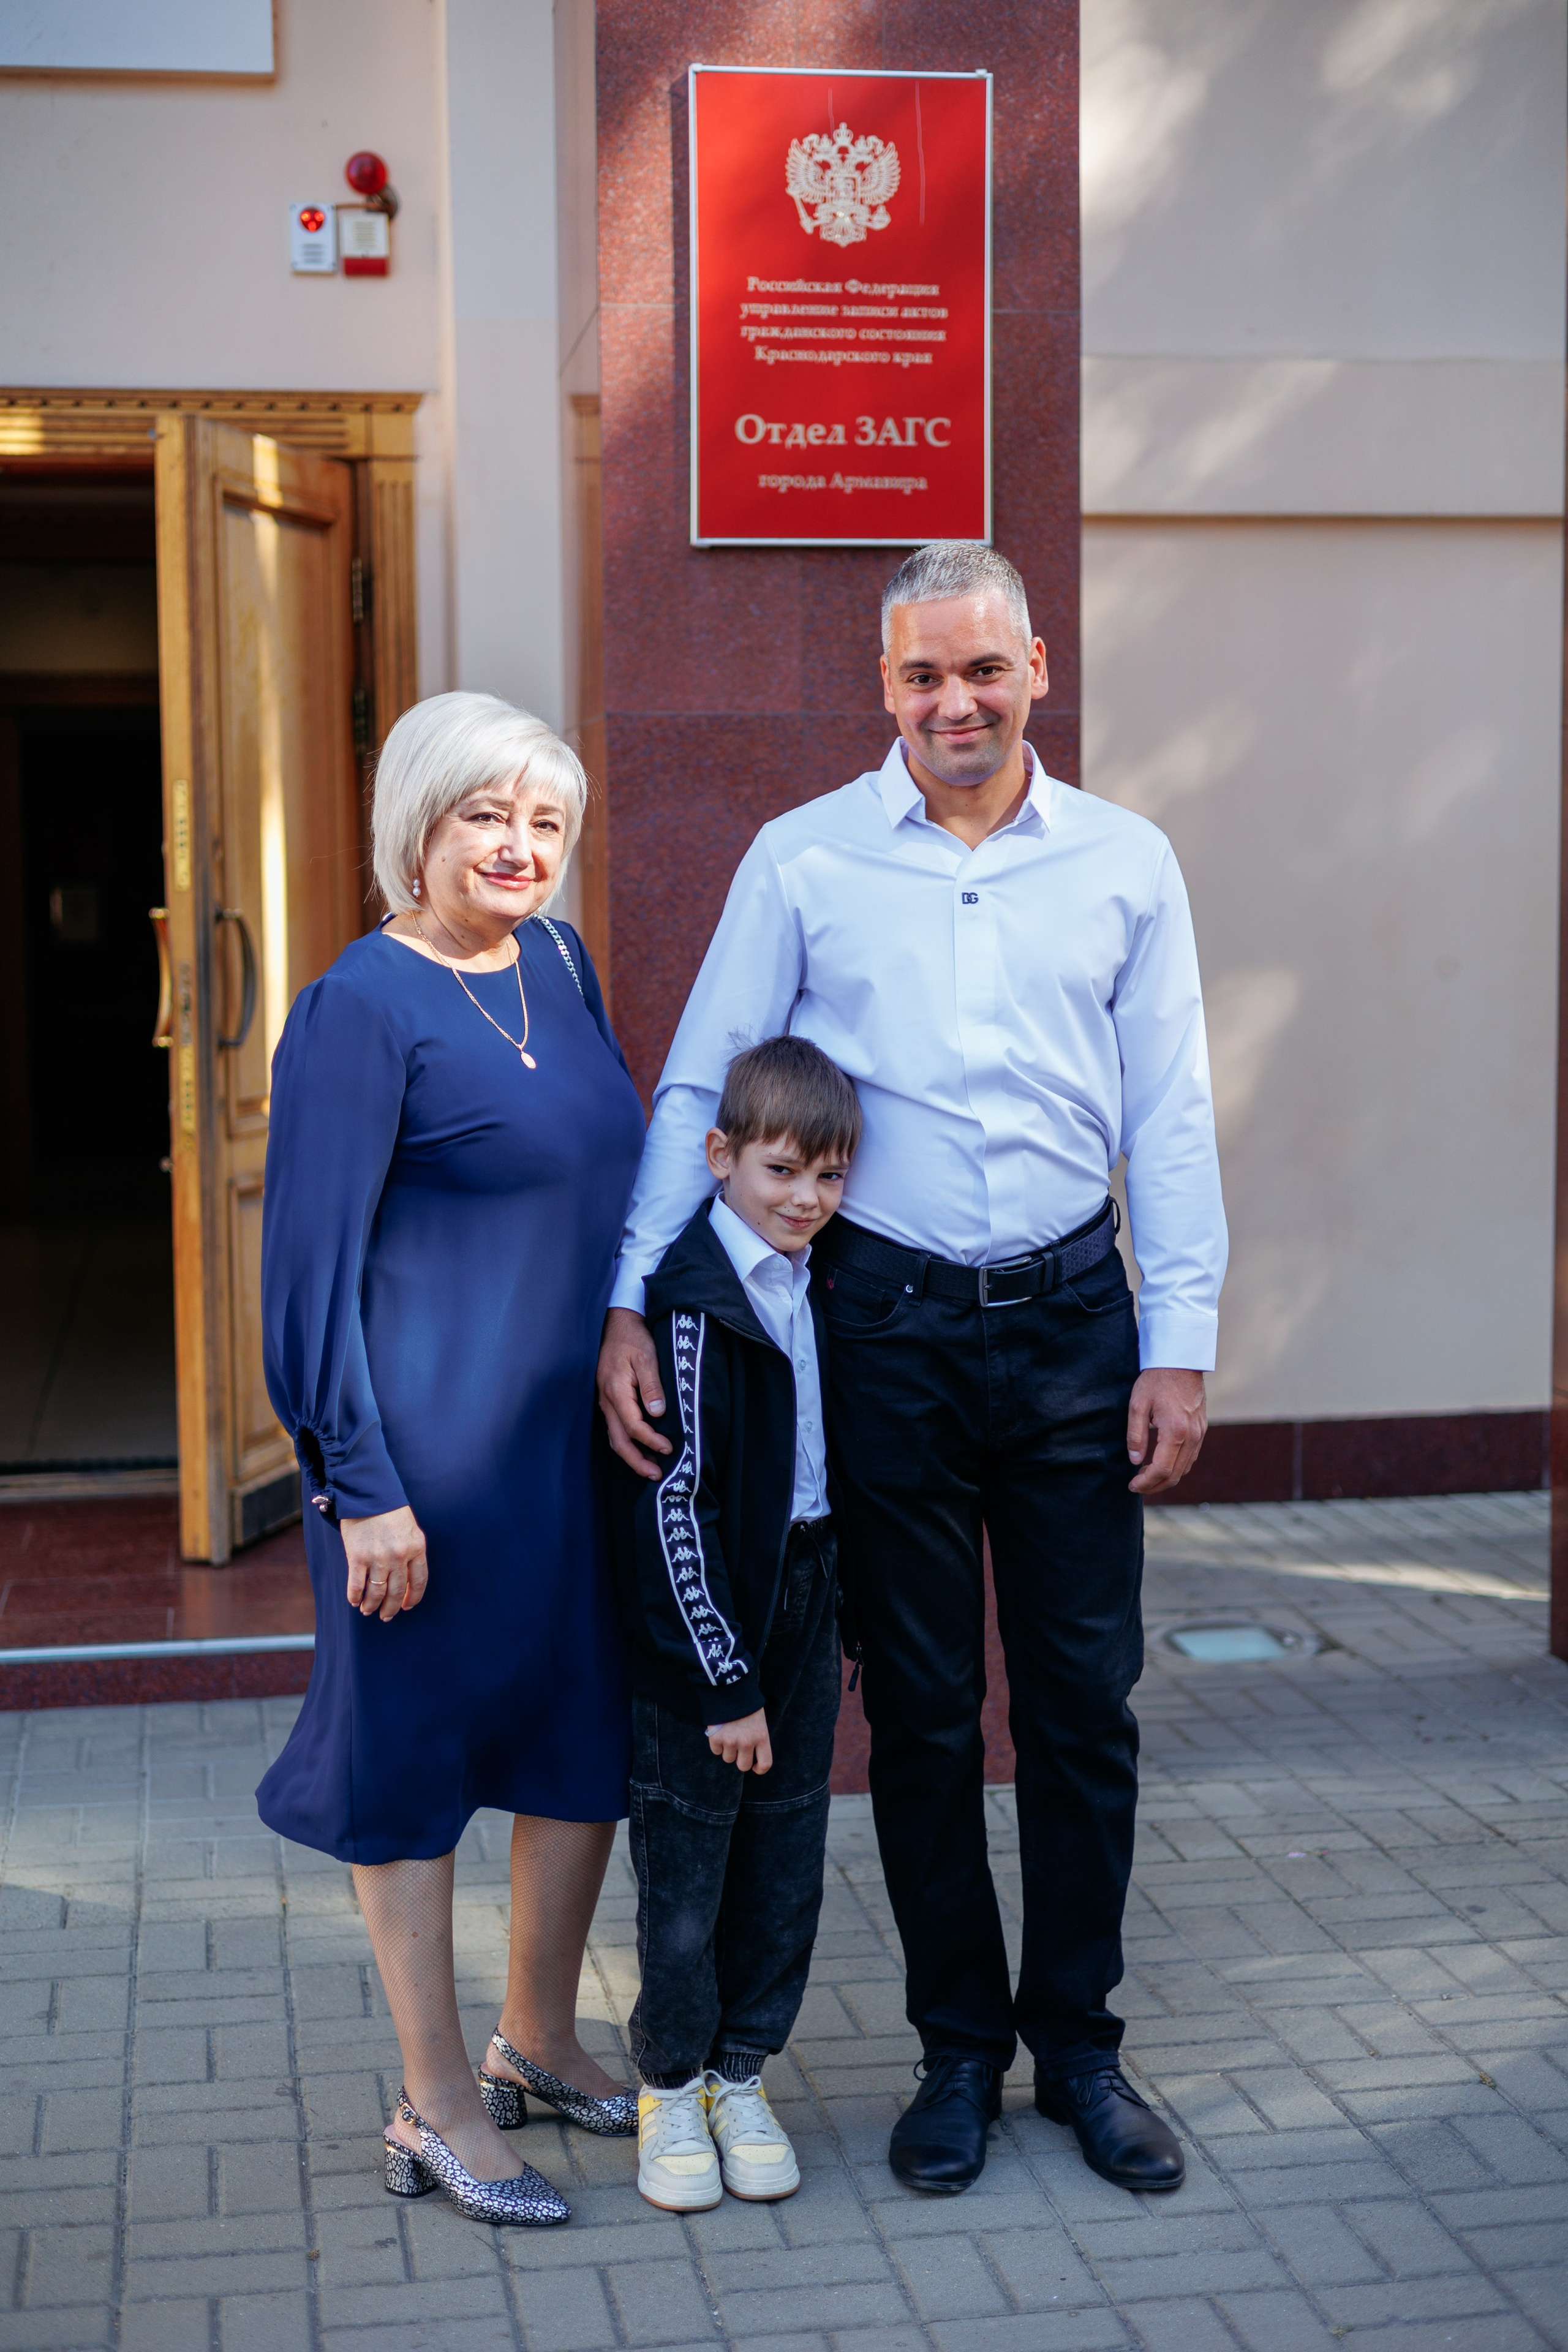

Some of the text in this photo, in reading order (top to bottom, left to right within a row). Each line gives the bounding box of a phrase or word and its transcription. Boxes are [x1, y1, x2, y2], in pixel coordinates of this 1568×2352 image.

[747, 276, 940, 300] Российская Федерация
[739, 303, 948, 319] управление записи актов
[741, 326, 947, 342] гражданского состояния
[755, 345, 933, 368] Краснодарского края
[735, 414, 952, 450] Отдел ЗАГС
[758, 472, 929, 495] города Армавира
[962, 892, 979, 904] DG
